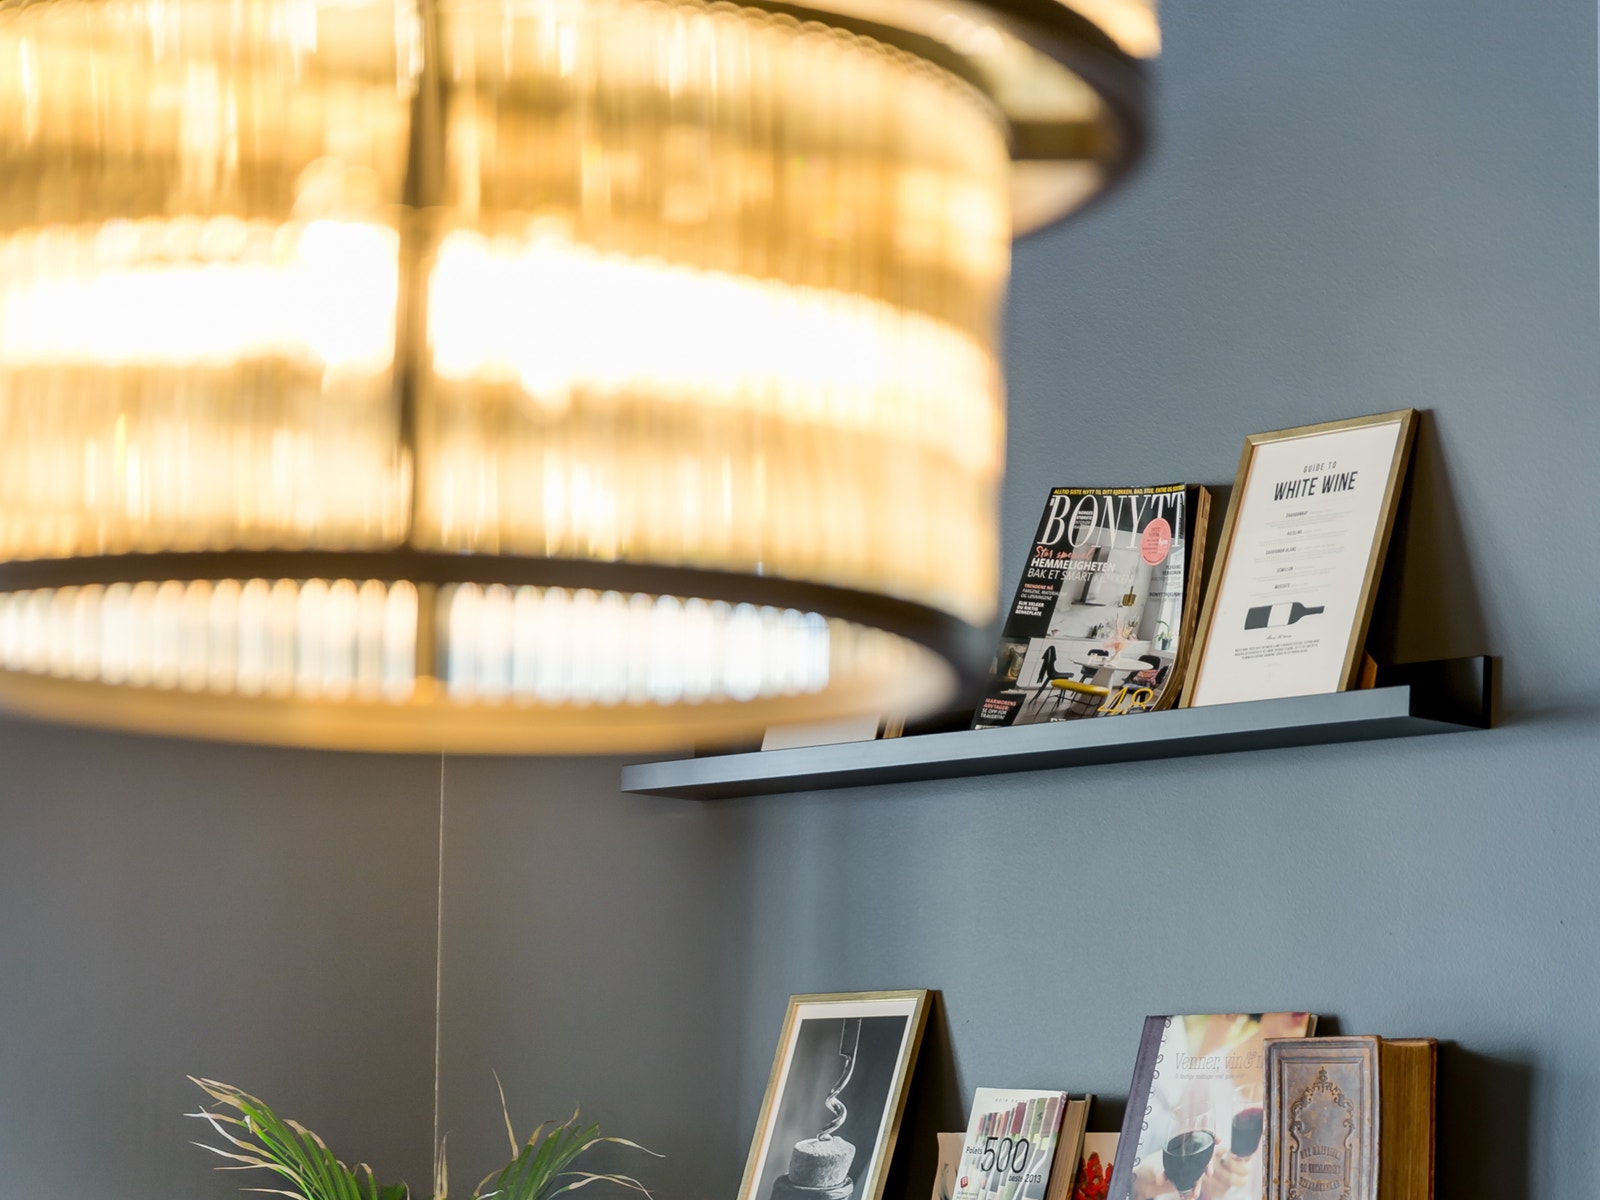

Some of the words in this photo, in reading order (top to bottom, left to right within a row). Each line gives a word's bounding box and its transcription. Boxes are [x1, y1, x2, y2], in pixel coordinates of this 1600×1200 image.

[1303, 462, 1325, 473] GUIDE
[1328, 461, 1337, 469] TO
[1274, 477, 1318, 501] WHITE
[1321, 471, 1358, 494] WINE
[1036, 490, 1185, 550] BONYTT
[1031, 558, 1117, 572] HEMMELIGHETEN
[1027, 568, 1046, 579] BAK
[1048, 568, 1060, 580] ET
[1060, 570, 1094, 582] SMART
[1175, 1052, 1221, 1071] Venner,
[980, 1136, 1030, 1174] 500
[1025, 1173, 1042, 1184] 2013
